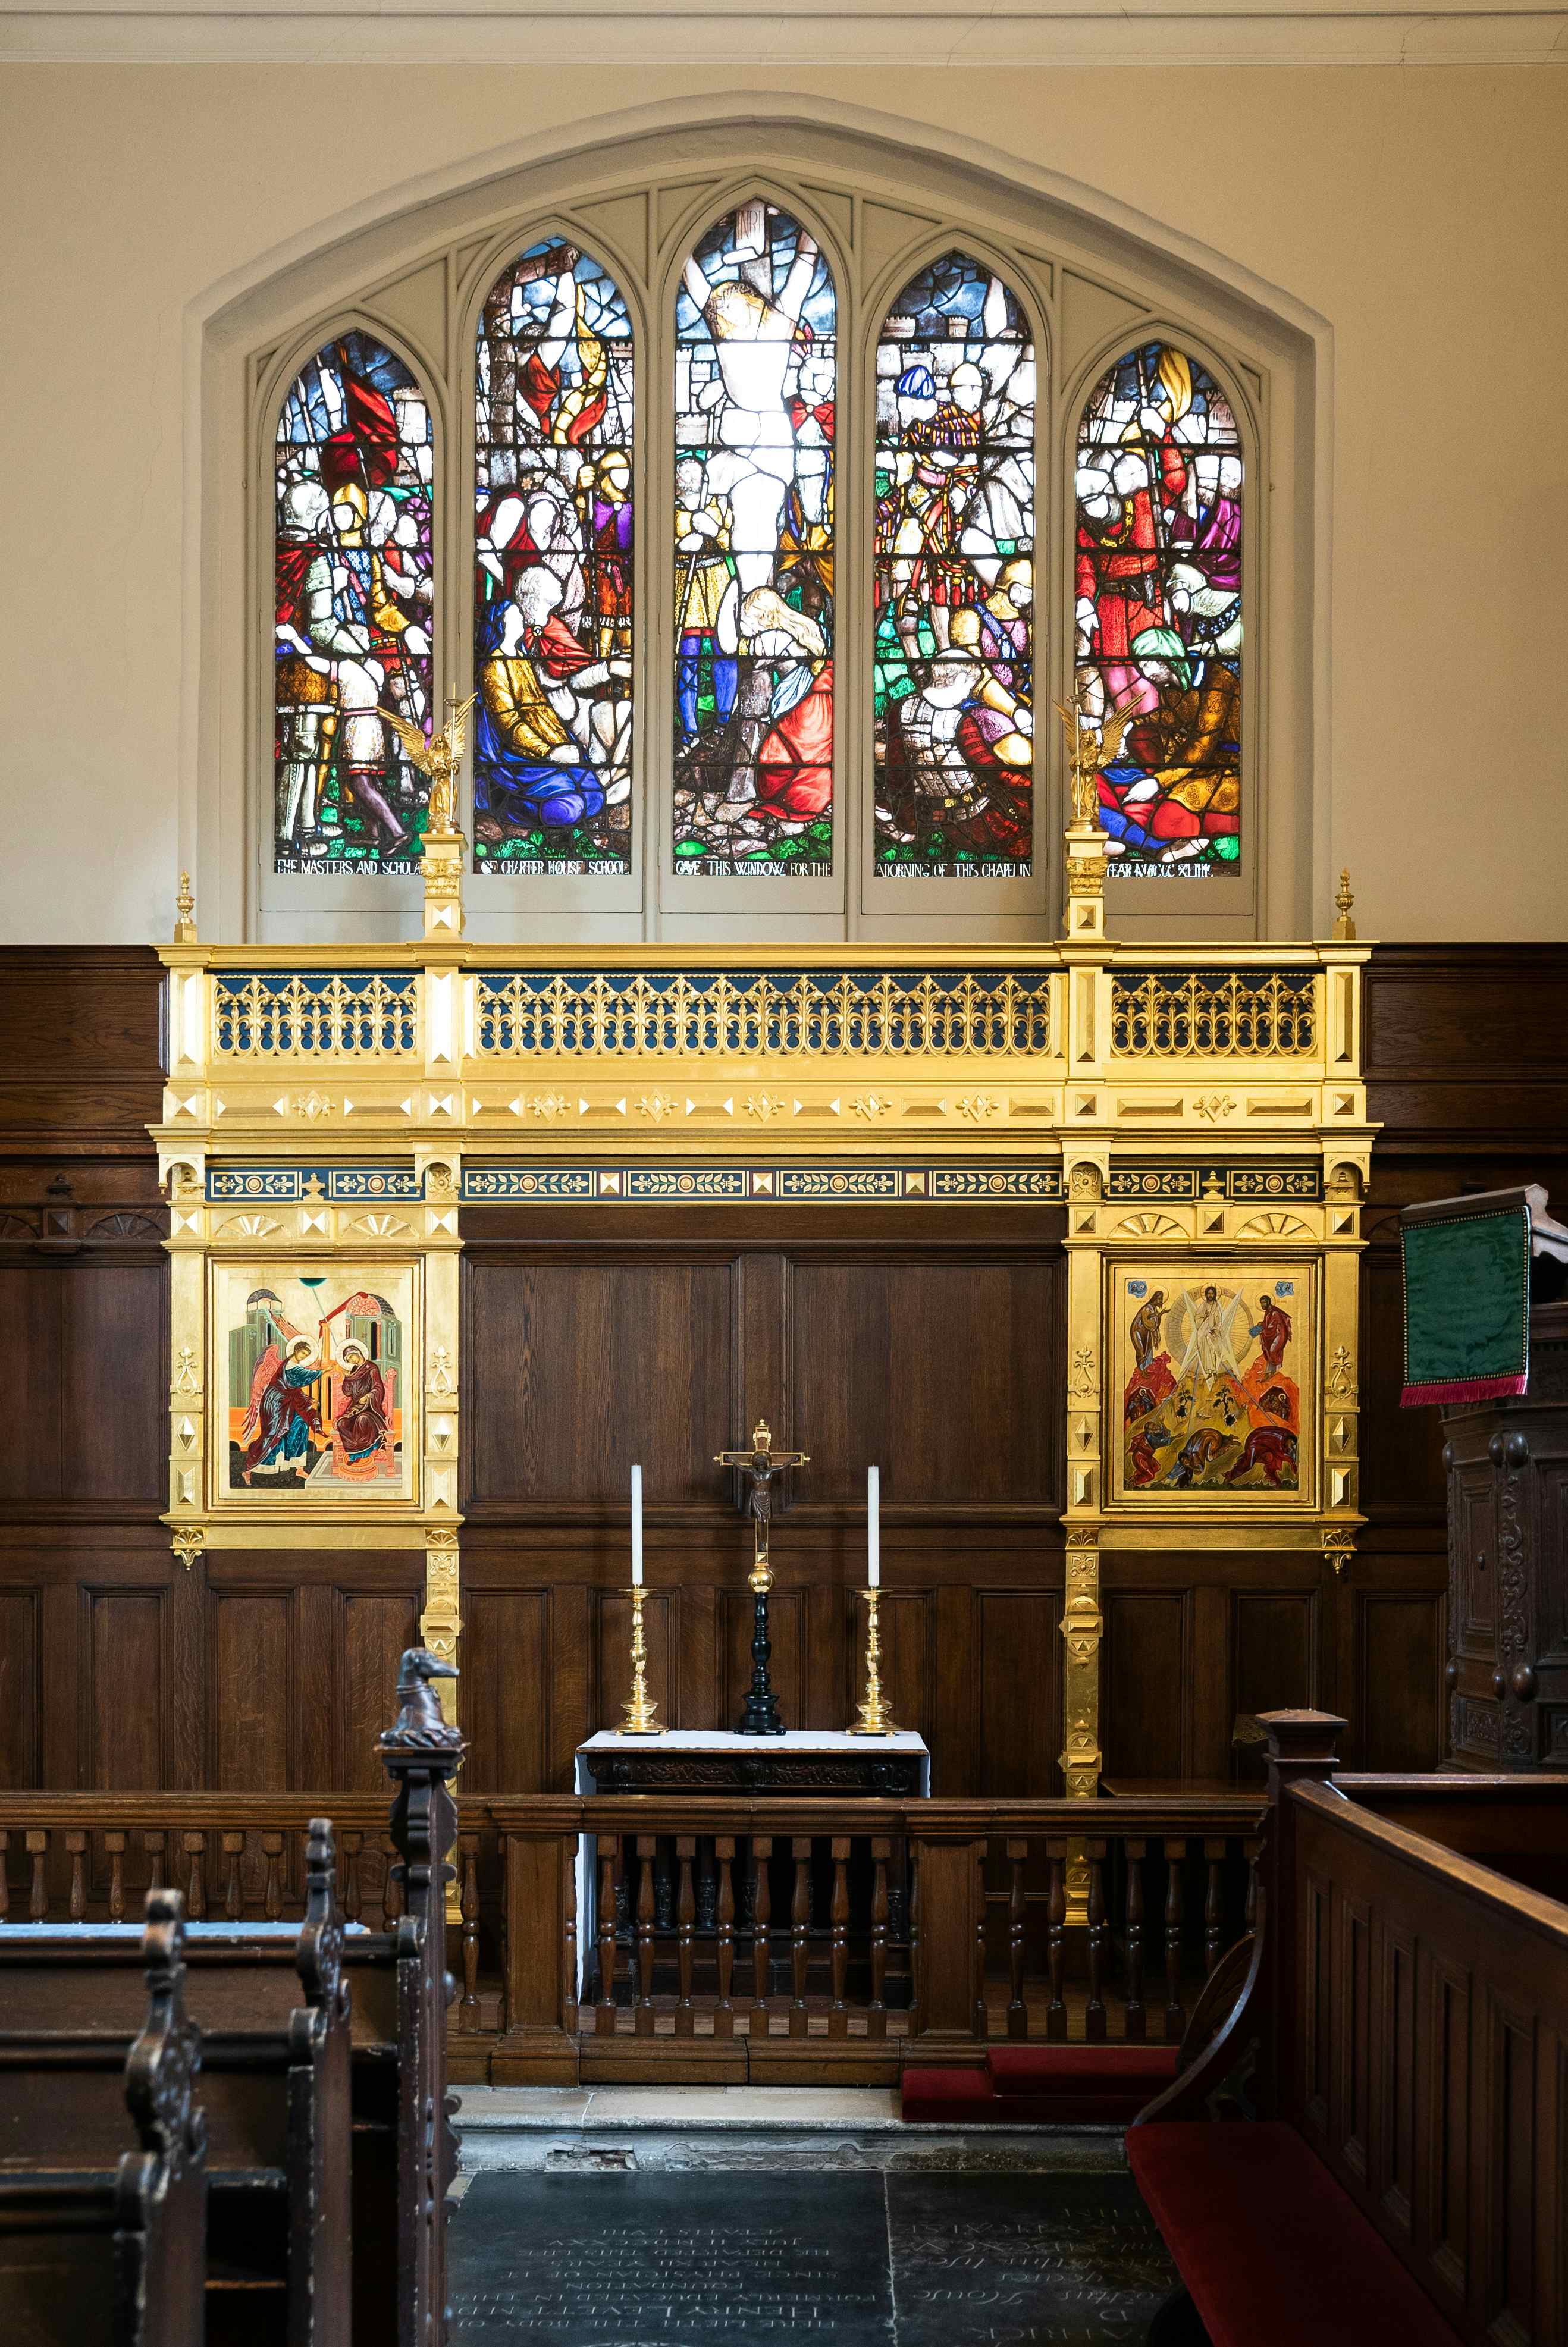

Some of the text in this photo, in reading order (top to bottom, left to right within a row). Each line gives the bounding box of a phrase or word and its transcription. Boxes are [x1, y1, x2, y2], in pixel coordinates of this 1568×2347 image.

[737, 209, 761, 239] INRI
[277, 859, 421, 875] THE MASTERS AND SCHOLA
[501, 860, 544, 874] CHARTER
[548, 861, 584, 874] HOUSE
[588, 860, 630, 875] SCHOOL
[675, 860, 701, 876] GAVE
[706, 861, 731, 876] THIS
[789, 862, 808, 876] FOR
[810, 862, 832, 876] THE
[875, 863, 930, 877] ADORNING
[933, 863, 948, 877] OF
[952, 863, 979, 877] THIS
[1020, 863, 1031, 877] IN
[687, 2306, 819, 2318] HENRY
